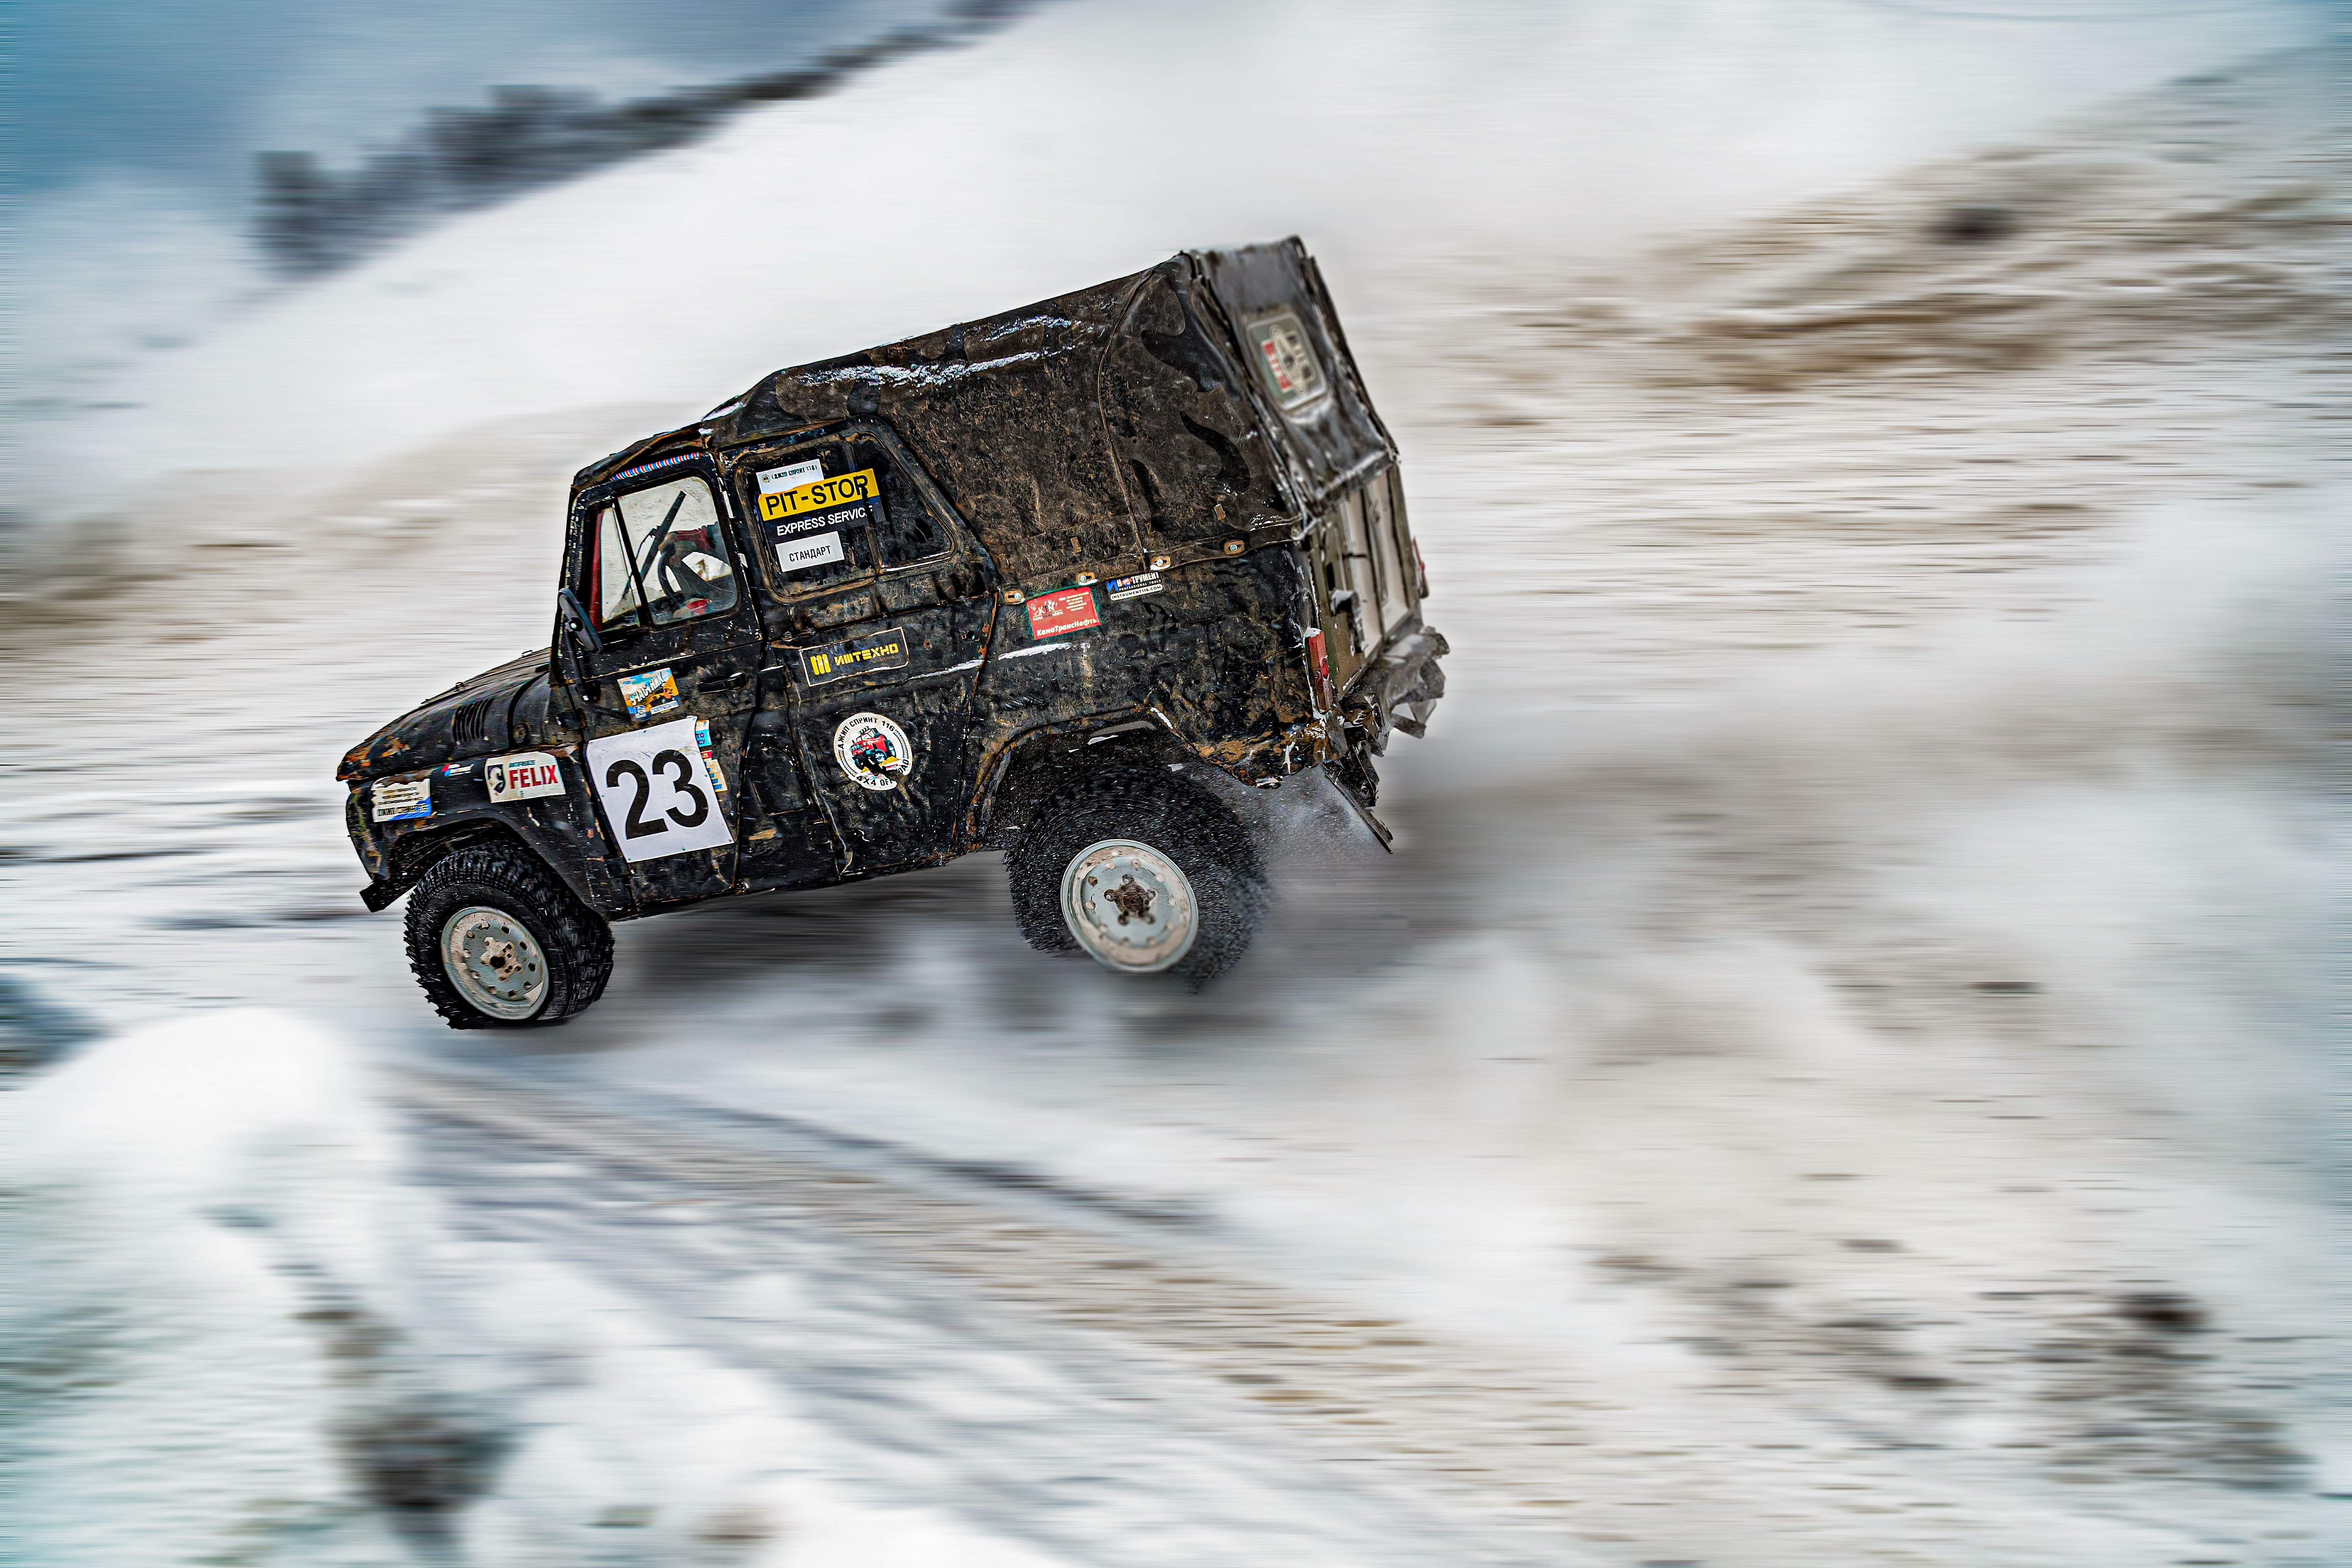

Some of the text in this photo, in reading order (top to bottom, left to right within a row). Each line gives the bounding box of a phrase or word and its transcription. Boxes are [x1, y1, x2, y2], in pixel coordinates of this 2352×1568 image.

[777, 517, 825, 536] EXPRESS
[789, 545, 831, 562] СТАНДАРТ
[1111, 585, 1161, 599] INSTRUMENT116.COM
[1119, 582, 1147, 591] PROFESSIONAL
[1037, 618, 1097, 637] КамаТрансНефть
[838, 717, 895, 749] ДЖИП СПРИНТ 116
[509, 765, 558, 789] FELIX
[606, 749, 709, 840] 23
